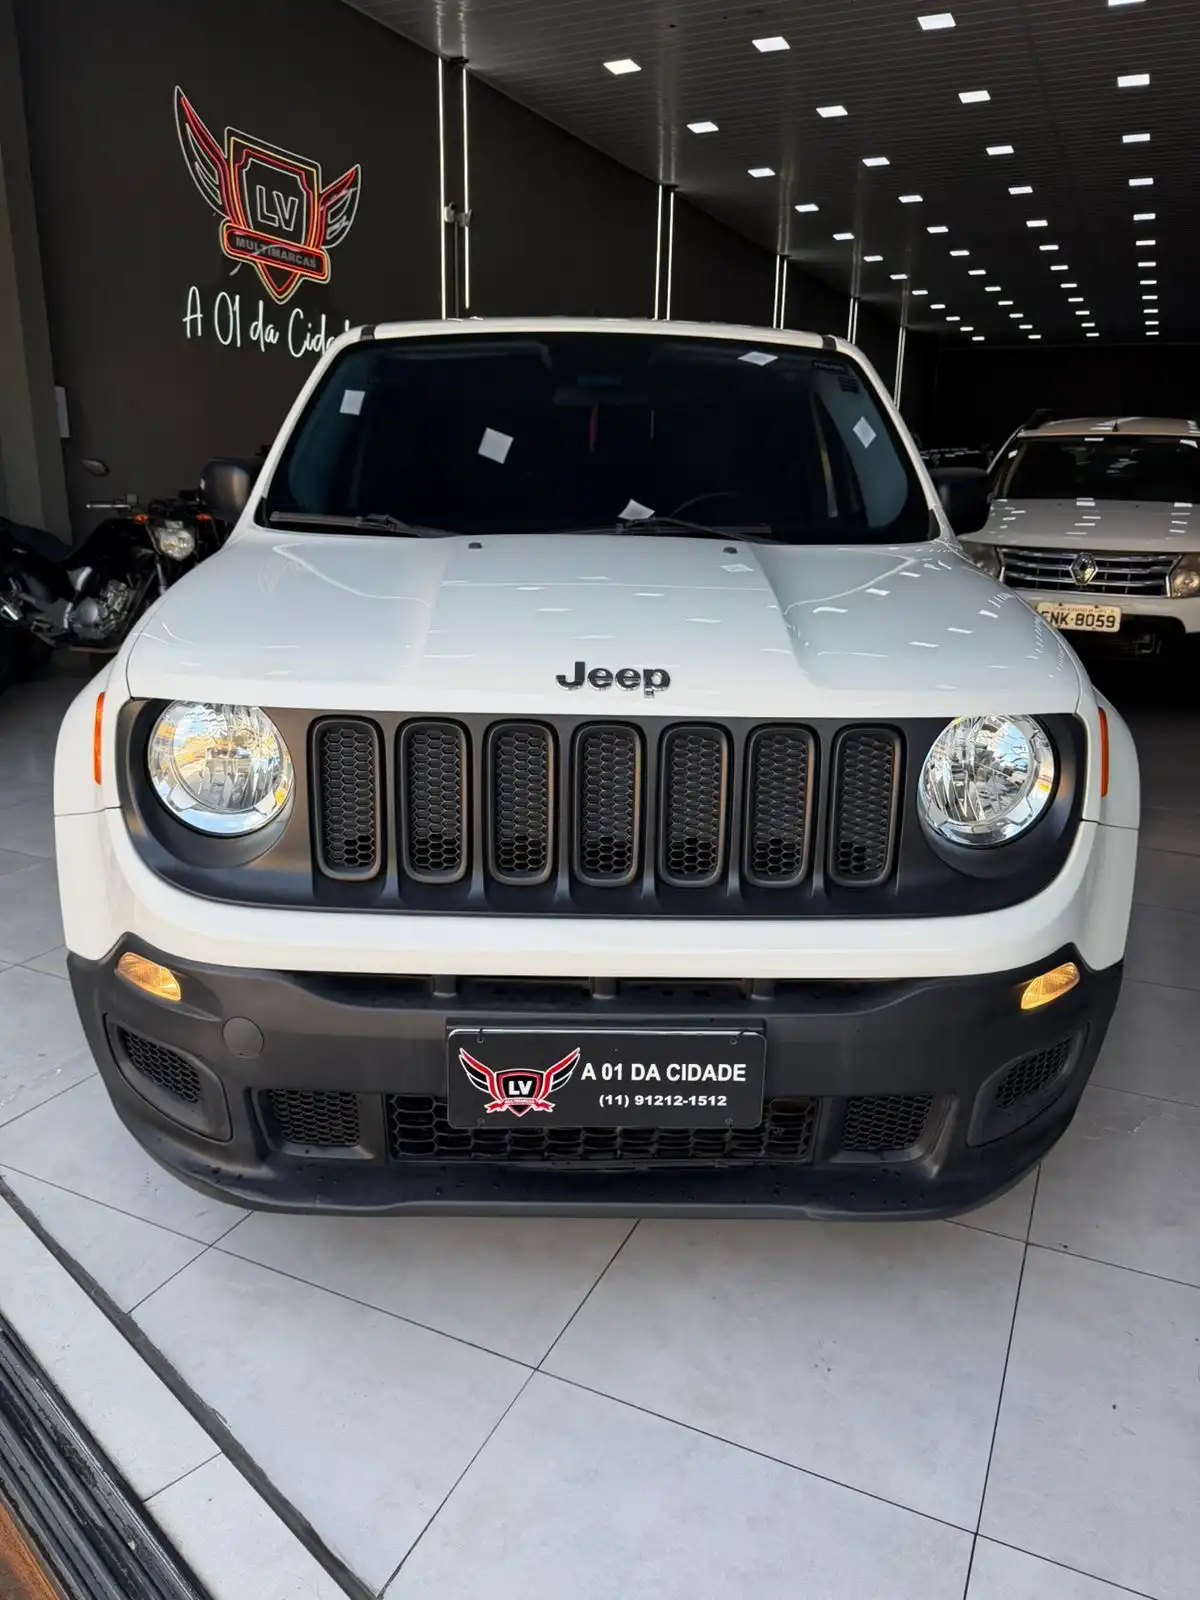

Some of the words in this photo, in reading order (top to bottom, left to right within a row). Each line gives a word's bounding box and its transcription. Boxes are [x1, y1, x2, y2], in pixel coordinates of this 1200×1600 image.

[256, 185, 299, 231] LV
[235, 236, 317, 268] MULTIMARCAS
[182, 286, 204, 339] A
[249, 300, 280, 352] da
[556, 661, 671, 698] Jeep
[508, 1080, 533, 1096] LV
[580, 1062, 597, 1081] A
[601, 1062, 624, 1081] 01
[631, 1063, 662, 1082] DA
[666, 1063, 747, 1082] CIDADE
[598, 1094, 630, 1108] (11)
[634, 1094, 728, 1107] 91212-1512
